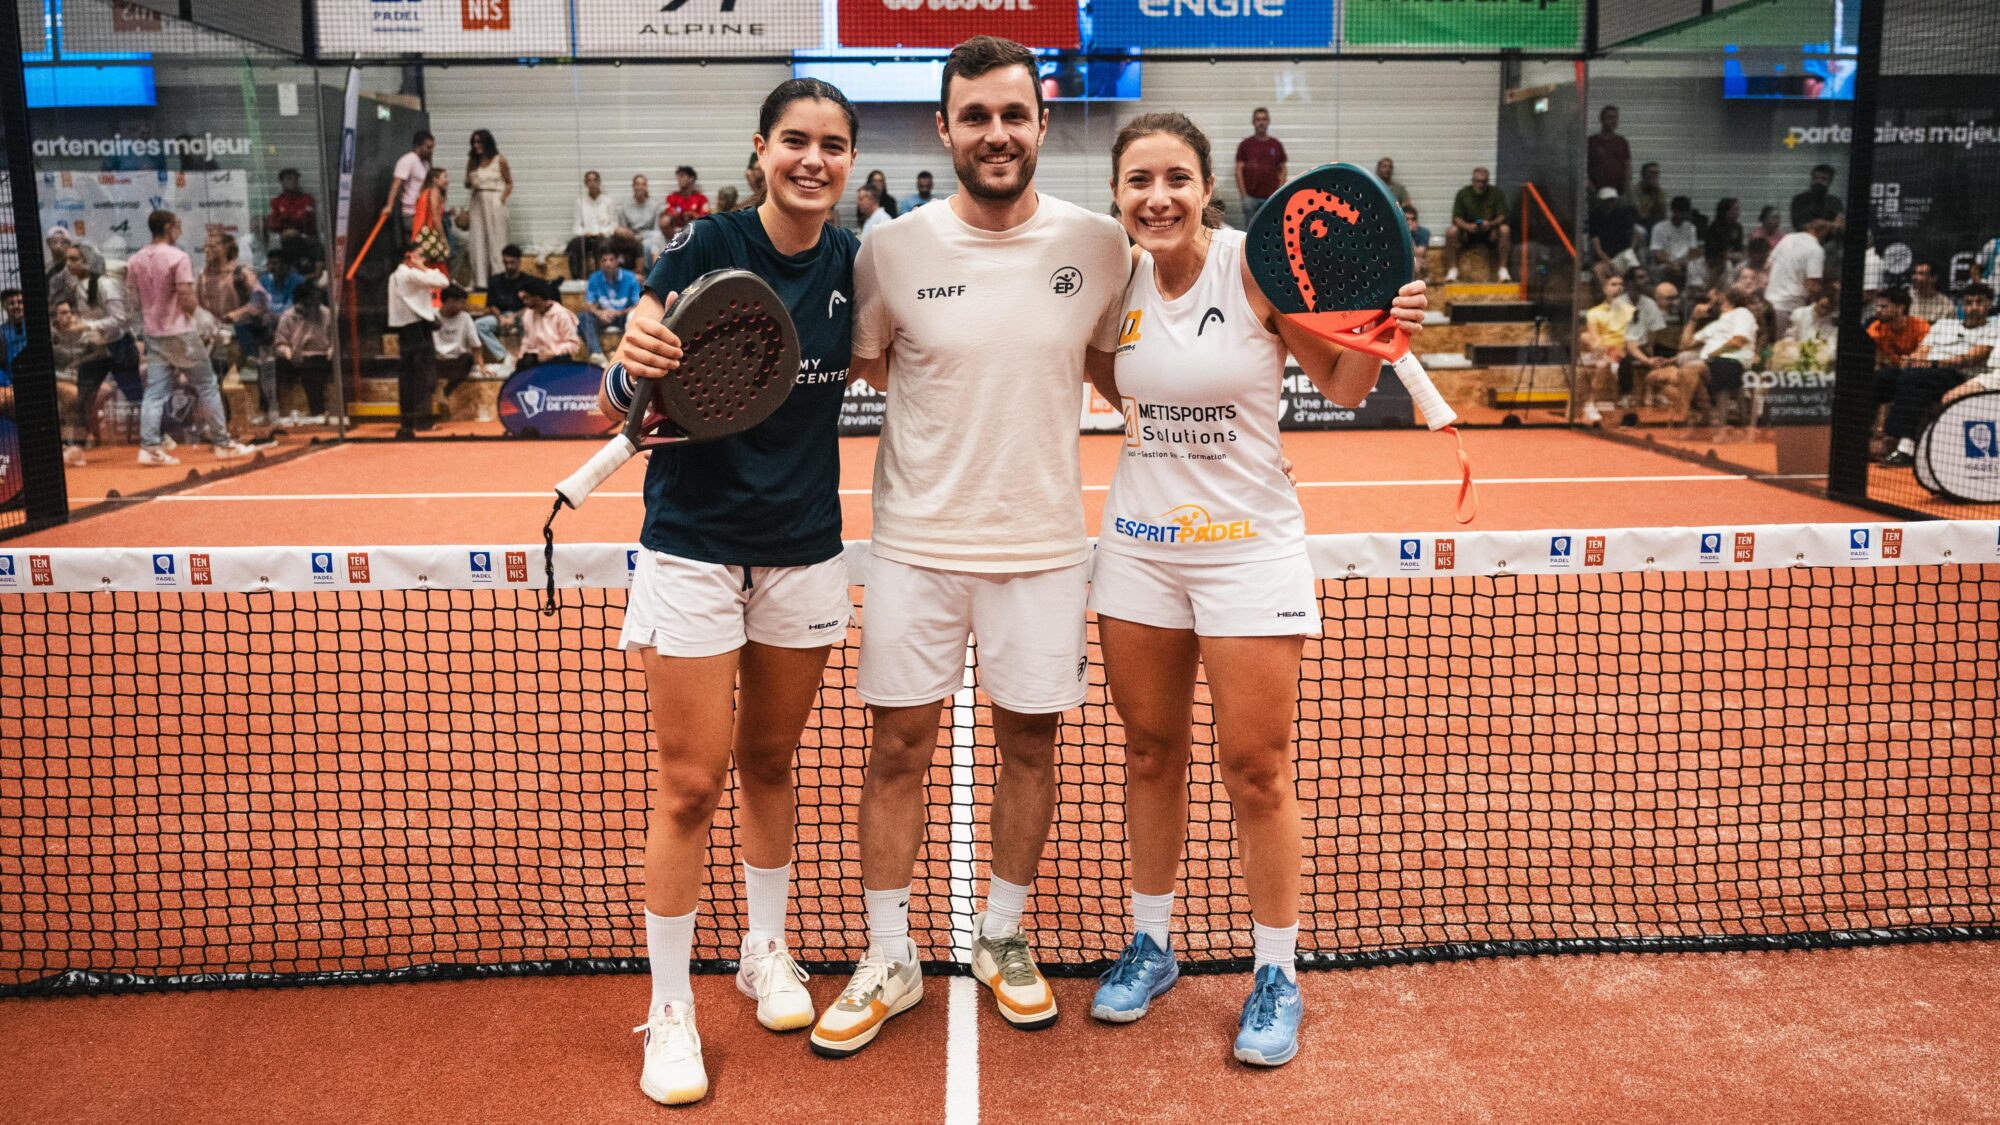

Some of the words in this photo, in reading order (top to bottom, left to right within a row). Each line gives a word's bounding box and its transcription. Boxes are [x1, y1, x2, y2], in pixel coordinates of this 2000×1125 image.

[373, 11, 419, 21] PADEL
[639, 24, 767, 35] ALPINE
[1789, 121, 1926, 148] parteaires
[32, 134, 160, 157] artenaires
[917, 285, 967, 300] STAFF
[1053, 282, 1074, 294] EP
[563, 402, 600, 411] FRANC
[842, 402, 859, 413] ne
[1293, 398, 1321, 409] Une
[1138, 403, 1238, 422] METISPORTS
[1293, 410, 1356, 422] d'avance
[1143, 426, 1238, 444] Solutions
[1188, 453, 1227, 461] Formation
[1736, 536, 1752, 545] TEN
[1884, 532, 1900, 541] TEN
[1437, 542, 1452, 551] TEN
[1588, 540, 1603, 549] TEN
[1736, 550, 1751, 559] NIS
[1884, 546, 1898, 555] NIS
[192, 558, 207, 567] TEN
[350, 556, 366, 566] TEN
[507, 555, 523, 565] TEN
[1437, 557, 1452, 566] NIS
[1587, 553, 1602, 563] NIS
[32, 559, 48, 568] TEN
[34, 573, 50, 583] NIS
[193, 572, 209, 582] NIS
[352, 570, 367, 580] NIS
[509, 569, 525, 579] NIS
[808, 620, 839, 630] HEAD
